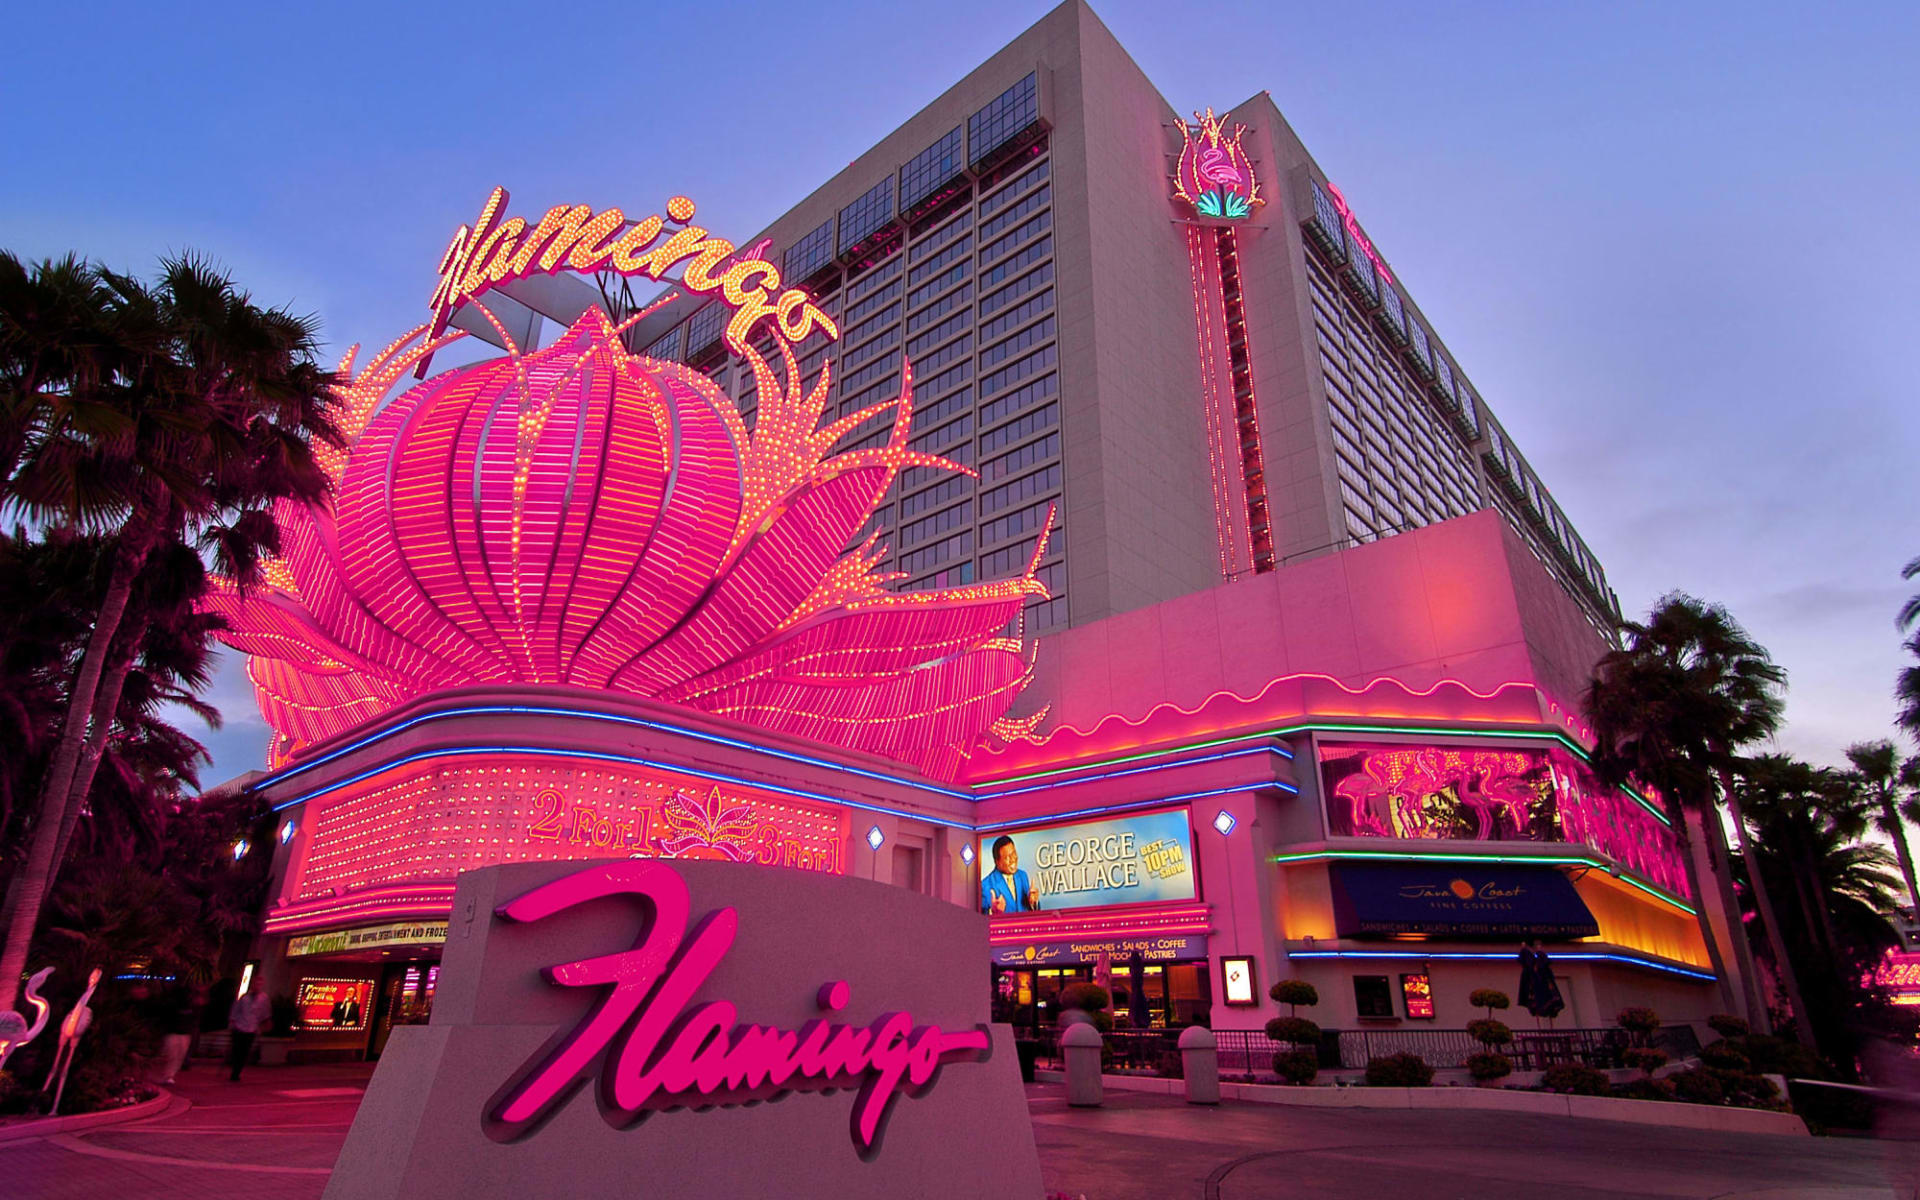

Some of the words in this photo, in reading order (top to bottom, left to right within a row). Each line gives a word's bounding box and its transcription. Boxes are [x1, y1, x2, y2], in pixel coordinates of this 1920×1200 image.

[529, 789, 565, 839] 2
[569, 807, 632, 847] For
[756, 823, 780, 865] 3
[1036, 831, 1137, 868] GEORGE
[1140, 840, 1164, 856] BEST
[1143, 845, 1184, 873] 10PM
[1159, 862, 1186, 879] SHOW
[1037, 861, 1139, 895] WALLACE
[1399, 884, 1451, 898] Java
[1478, 881, 1528, 900] Coast
[425, 927, 448, 937] FROZE
[1071, 943, 1115, 953] SANDWICHES
[1157, 939, 1187, 949] COFFEE
[1080, 952, 1100, 962] LATT
[1144, 950, 1176, 959] PASTRIES
[494, 860, 989, 1150] Flamingo
